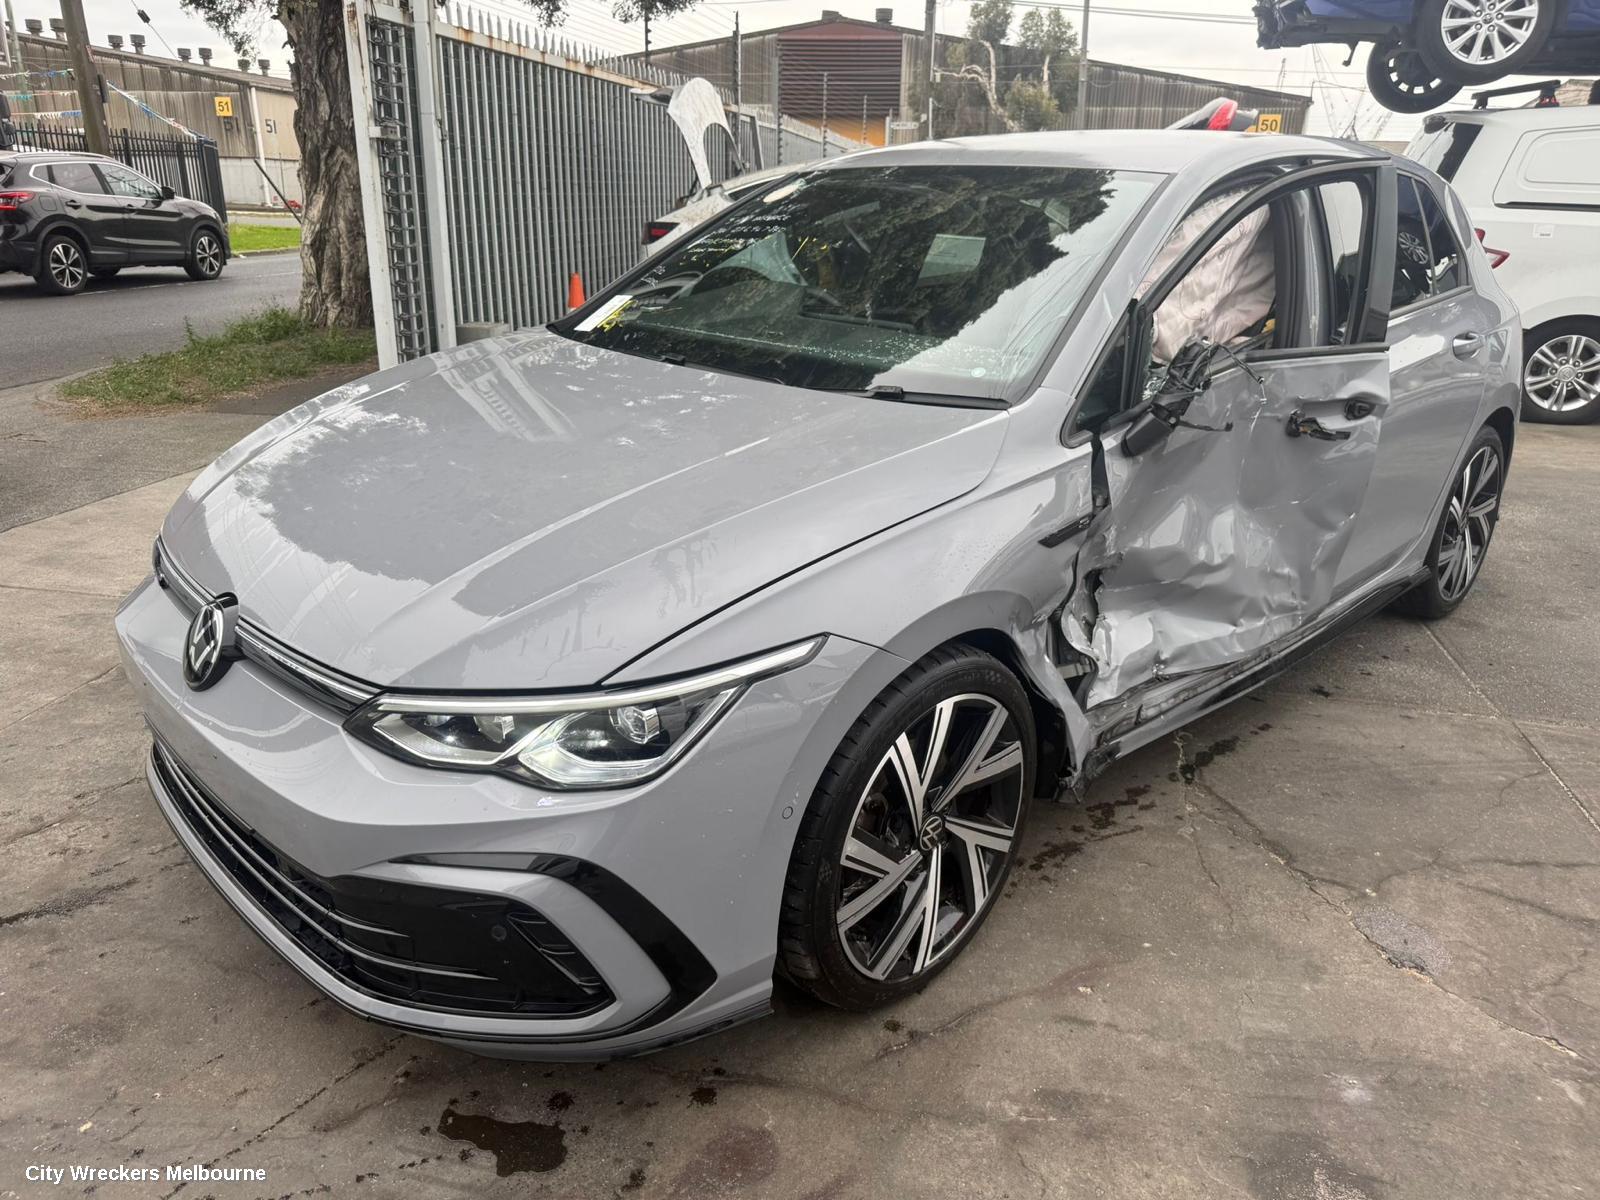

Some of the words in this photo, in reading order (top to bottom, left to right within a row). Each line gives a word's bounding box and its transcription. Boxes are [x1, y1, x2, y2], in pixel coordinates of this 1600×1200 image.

[218, 101, 230, 112] 51
[265, 119, 278, 134] 51
[1260, 119, 1278, 131] 50
